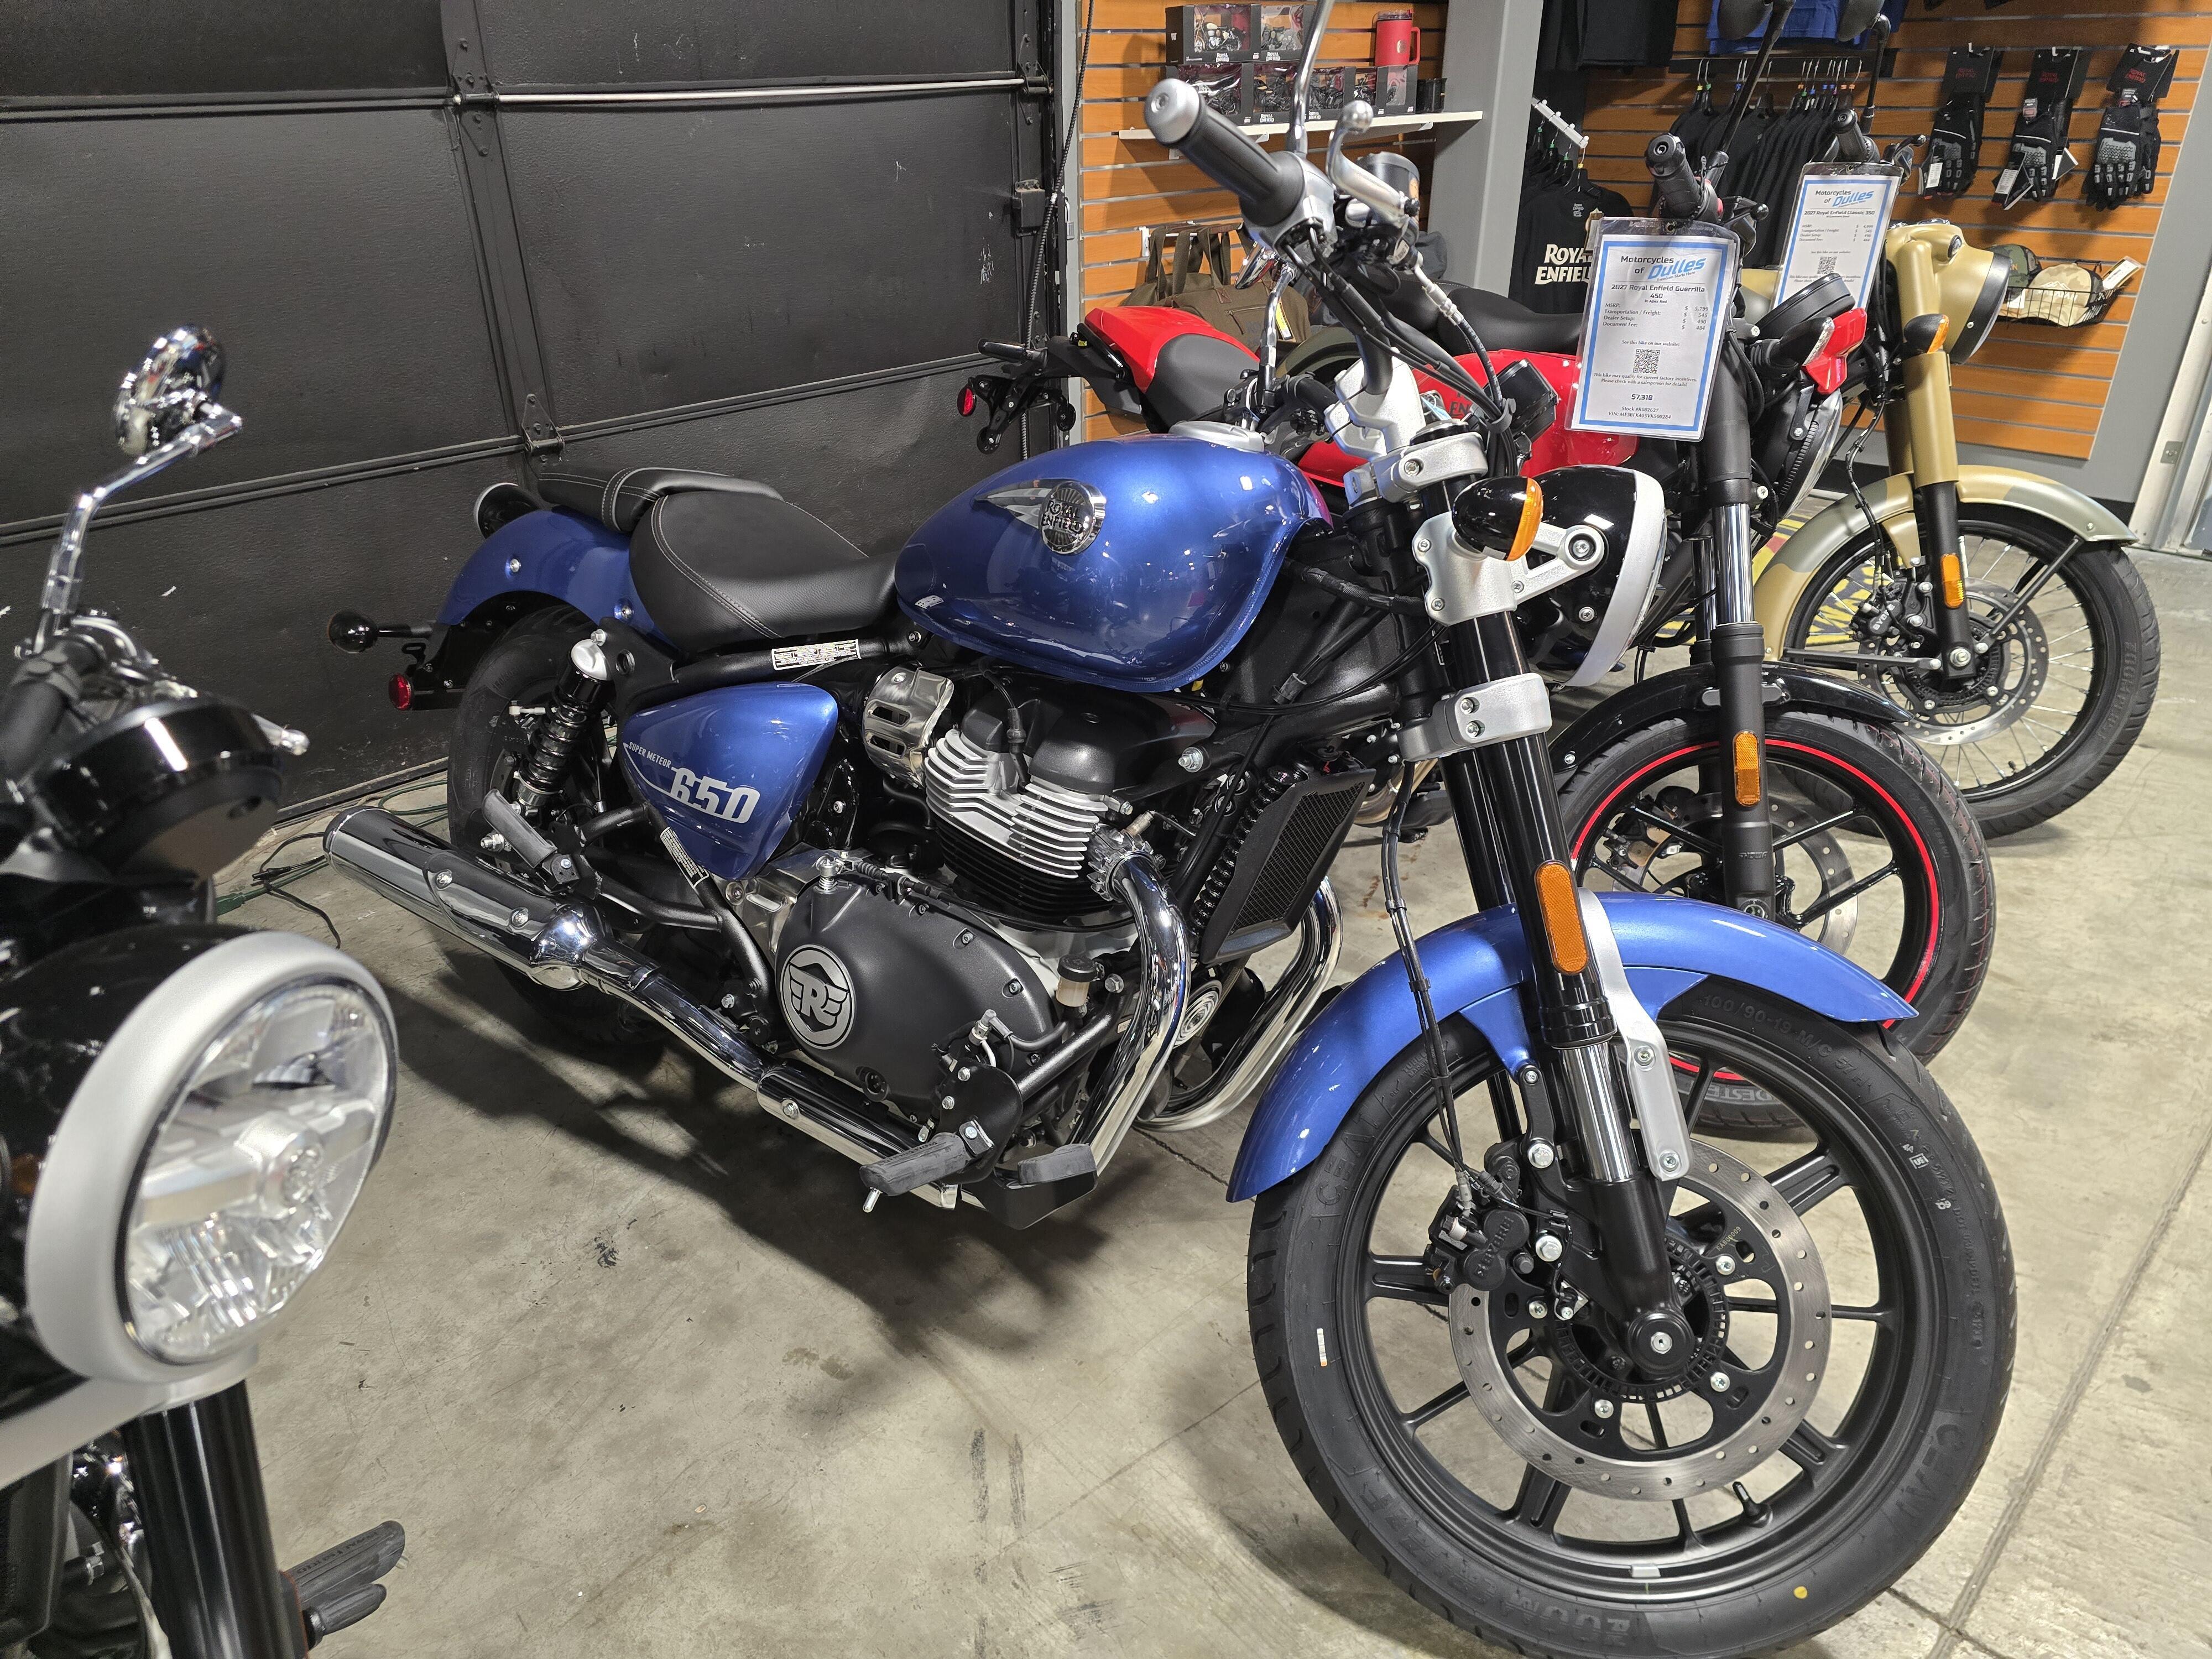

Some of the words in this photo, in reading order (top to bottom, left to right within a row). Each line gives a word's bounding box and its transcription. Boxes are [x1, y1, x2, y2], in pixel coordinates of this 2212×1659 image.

[1832, 191, 1874, 207] Dulles
[1535, 267, 1592, 285] ENFIEL
[1647, 258, 1707, 280] Dulles
[628, 742, 646, 757] SUPER
[646, 750, 672, 769] METEOR
[671, 766, 760, 823] 650
[1704, 996, 1792, 1034] 100/90-19
